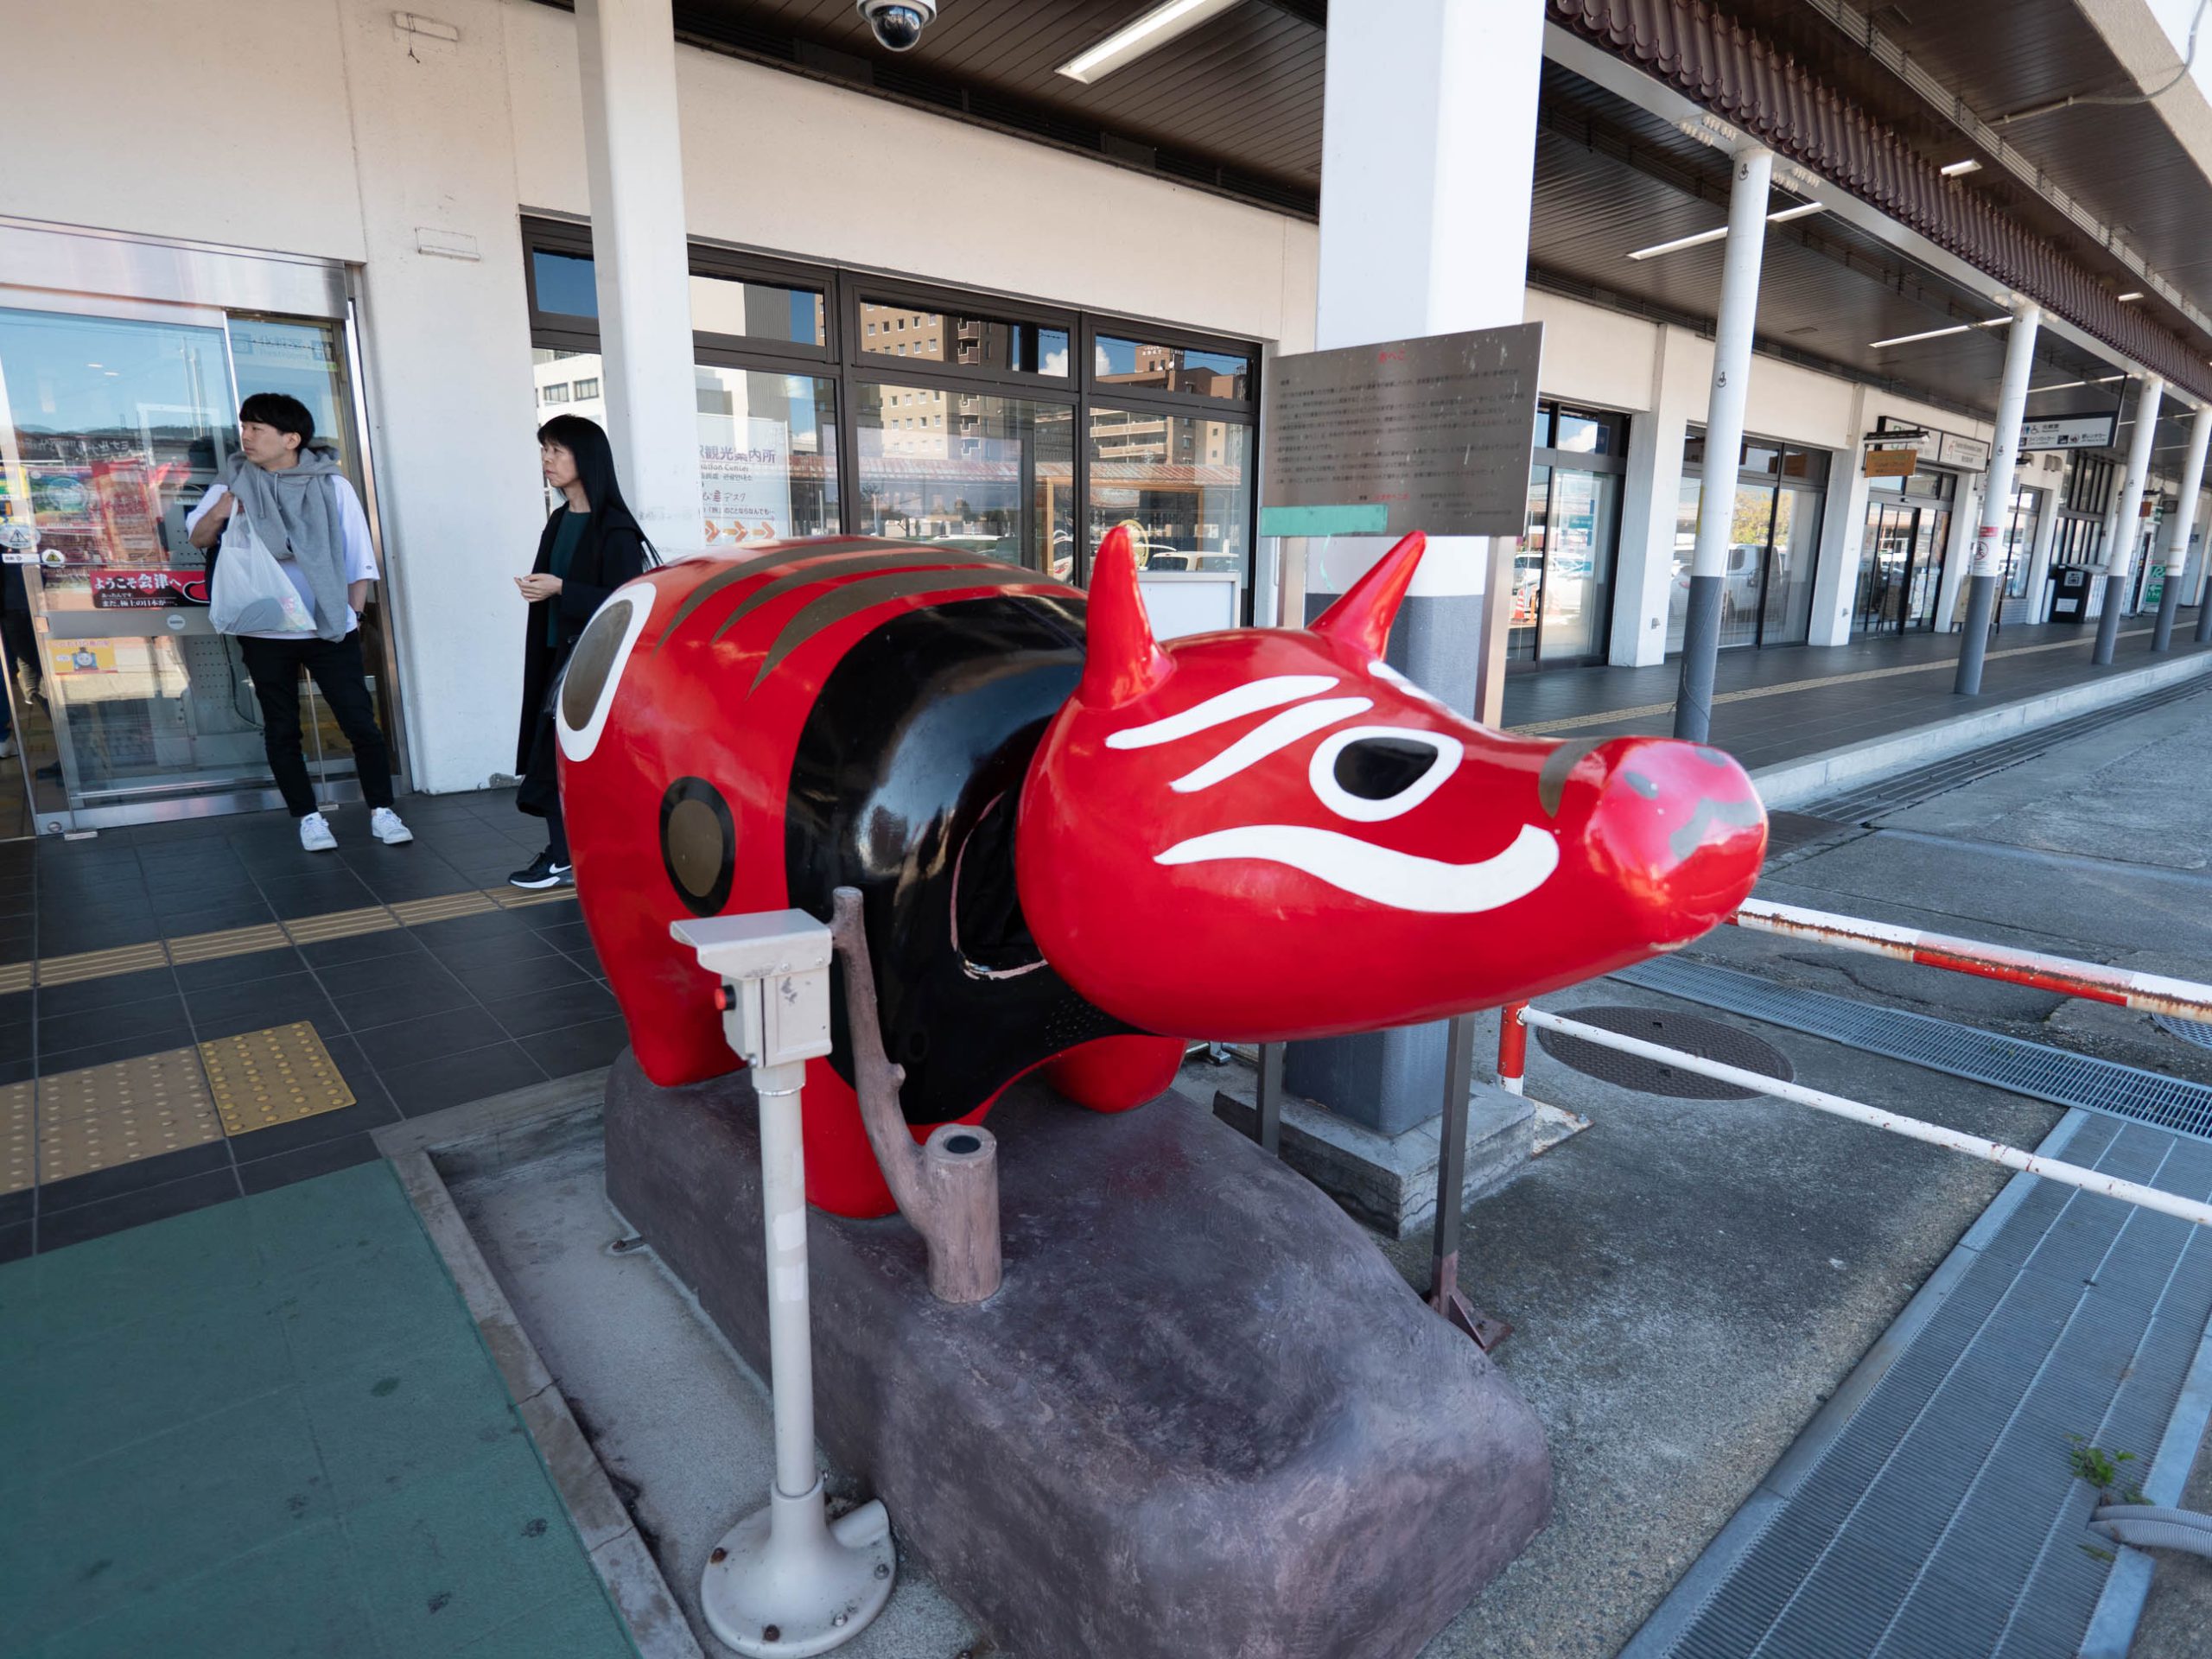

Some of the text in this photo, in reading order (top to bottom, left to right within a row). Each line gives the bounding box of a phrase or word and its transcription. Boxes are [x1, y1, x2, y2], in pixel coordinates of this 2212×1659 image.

[95, 573, 181, 590] ようこそ会津へ
